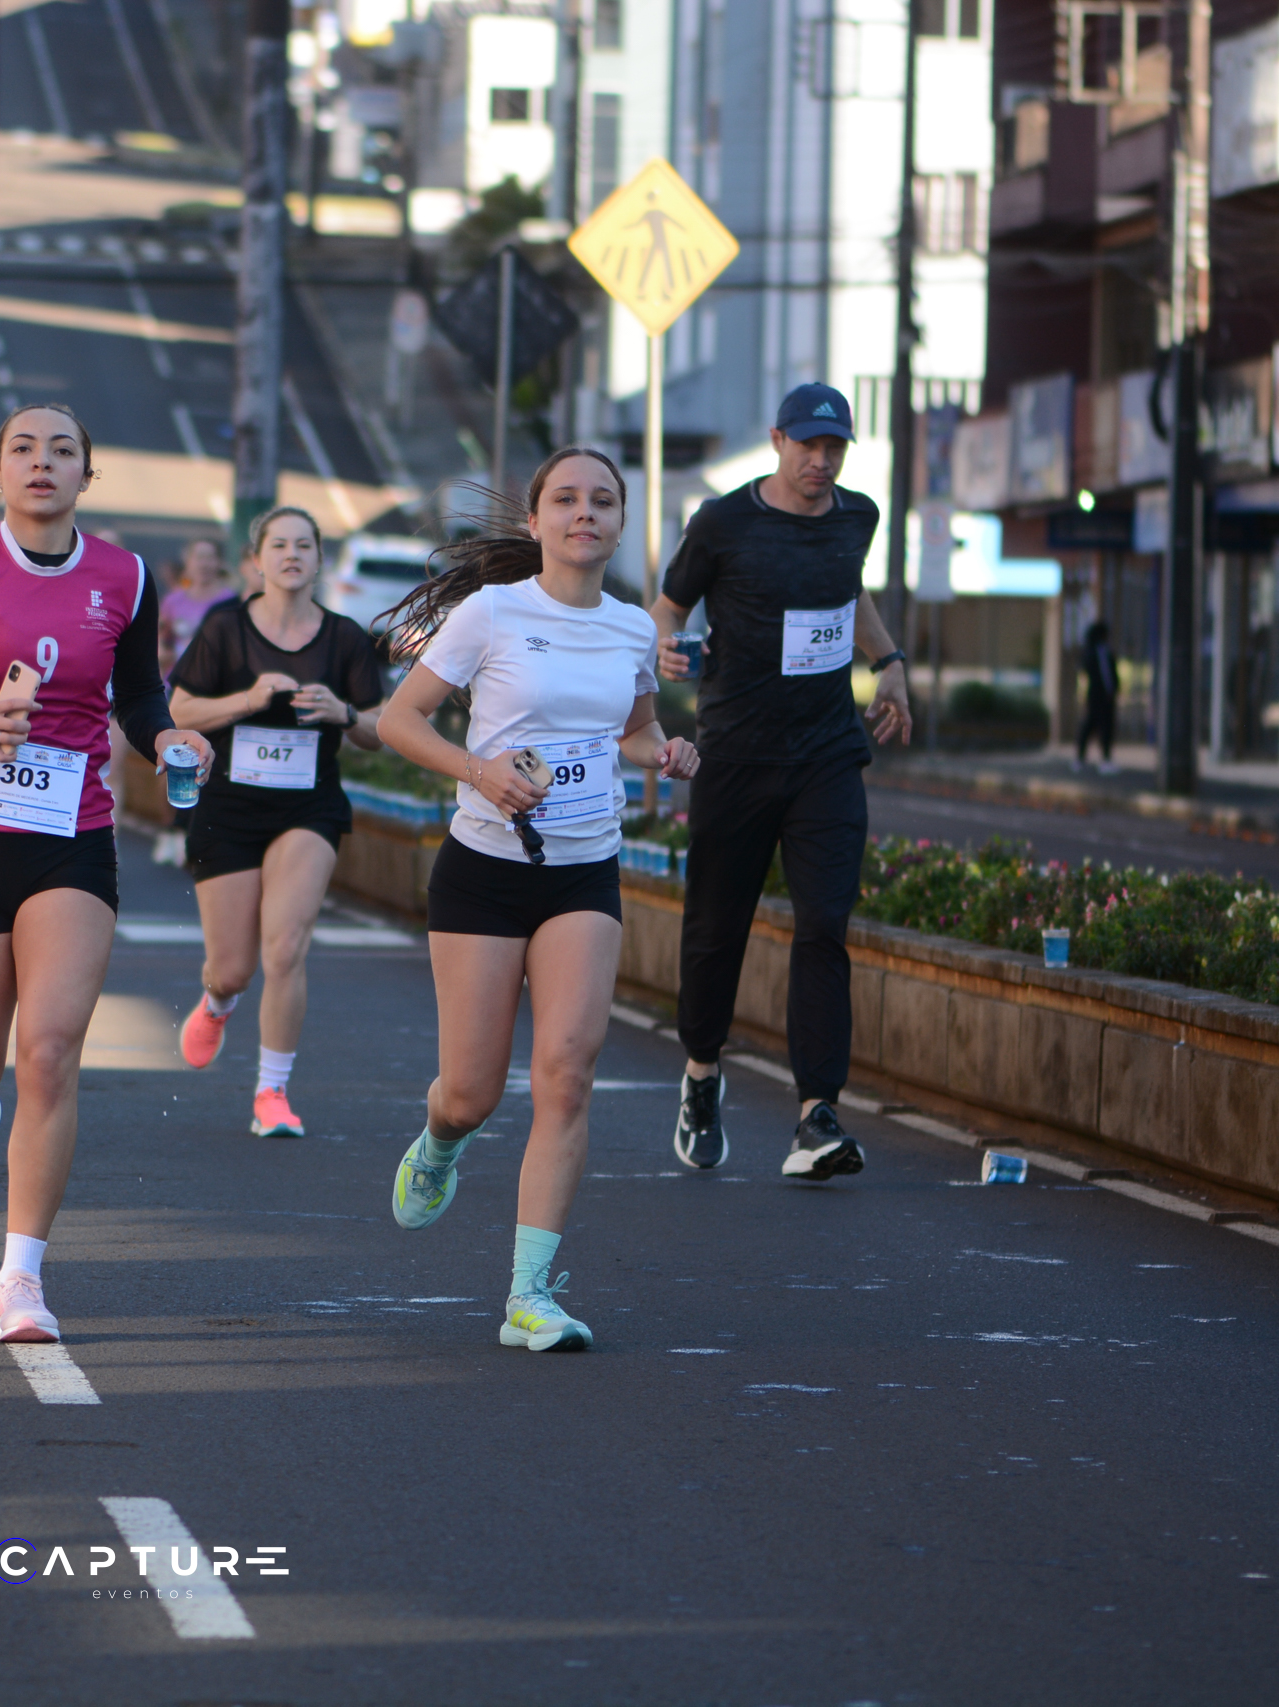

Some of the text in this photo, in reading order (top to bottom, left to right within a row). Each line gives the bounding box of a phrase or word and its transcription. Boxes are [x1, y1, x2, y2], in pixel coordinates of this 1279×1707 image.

[810, 625, 843, 644] 295
[36, 636, 59, 684] 9
[257, 746, 294, 762] 047
[0, 763, 51, 791] 303
[550, 763, 586, 786] 99
